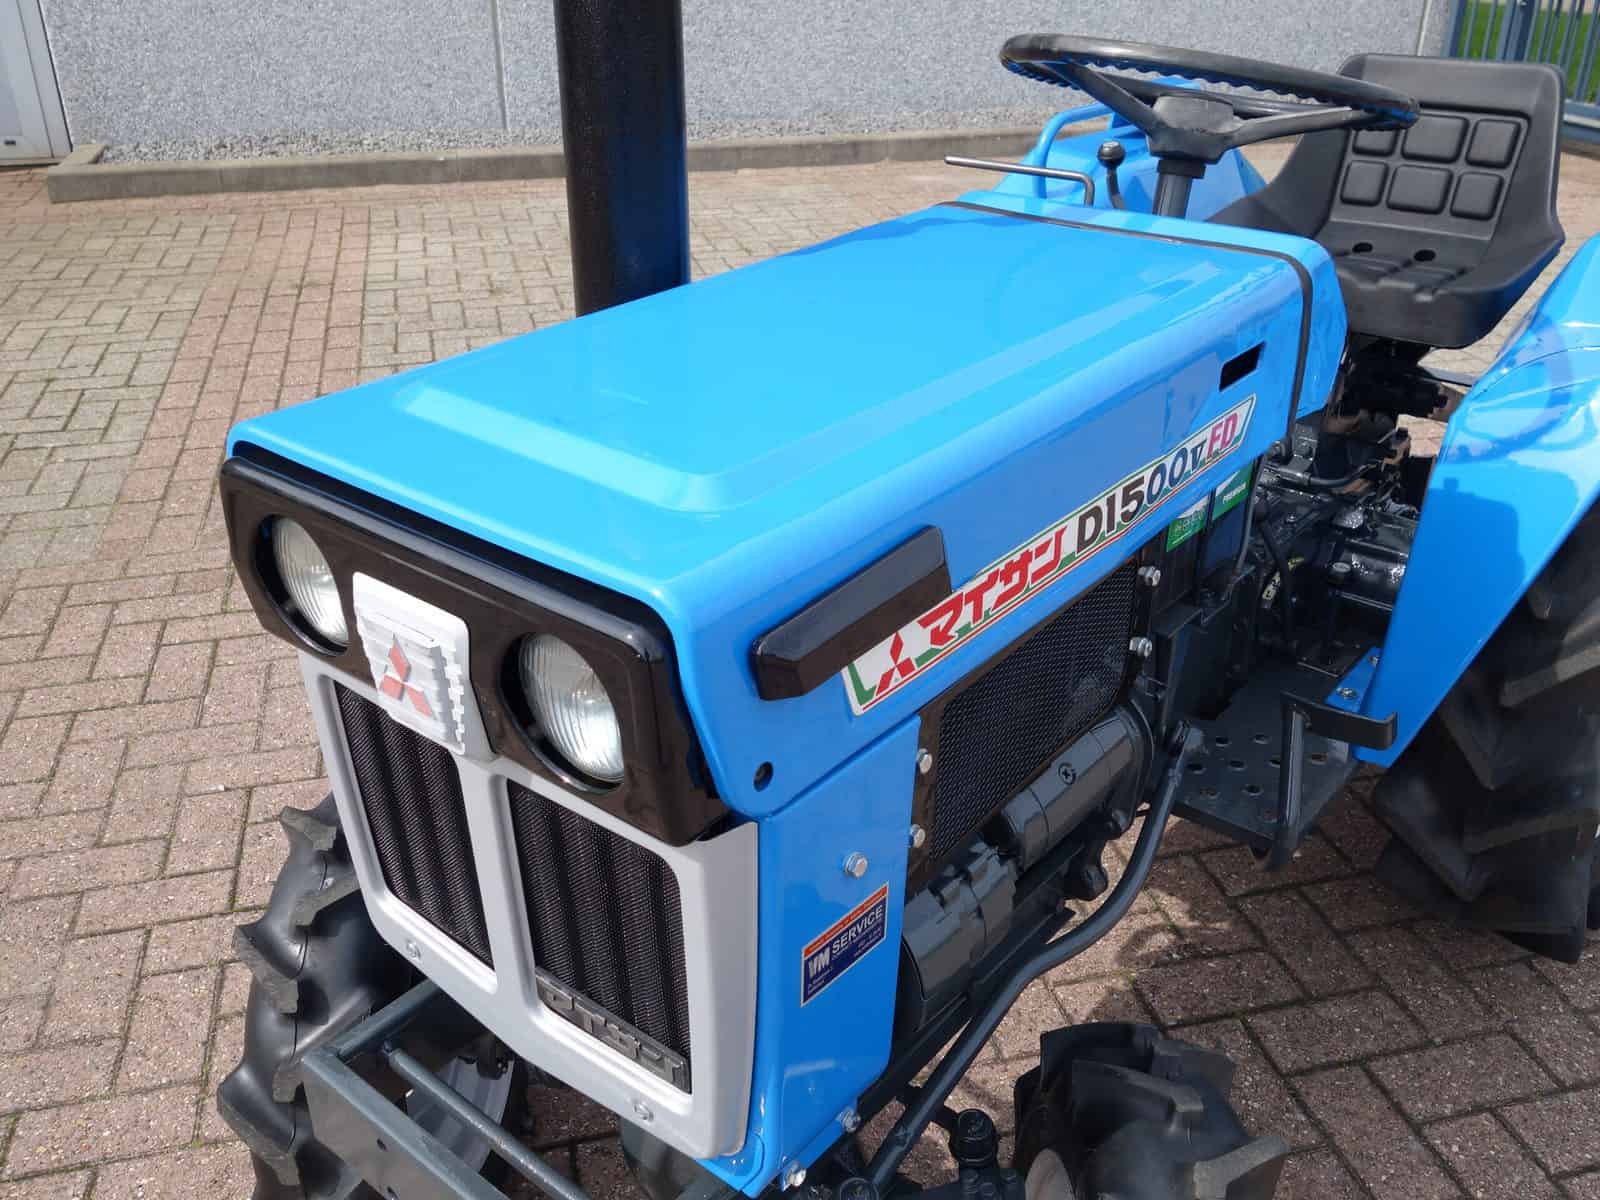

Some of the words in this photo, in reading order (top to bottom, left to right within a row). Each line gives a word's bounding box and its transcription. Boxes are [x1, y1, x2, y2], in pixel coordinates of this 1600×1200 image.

[917, 525, 1068, 646] マイサン
[832, 903, 883, 954] SERVICE
